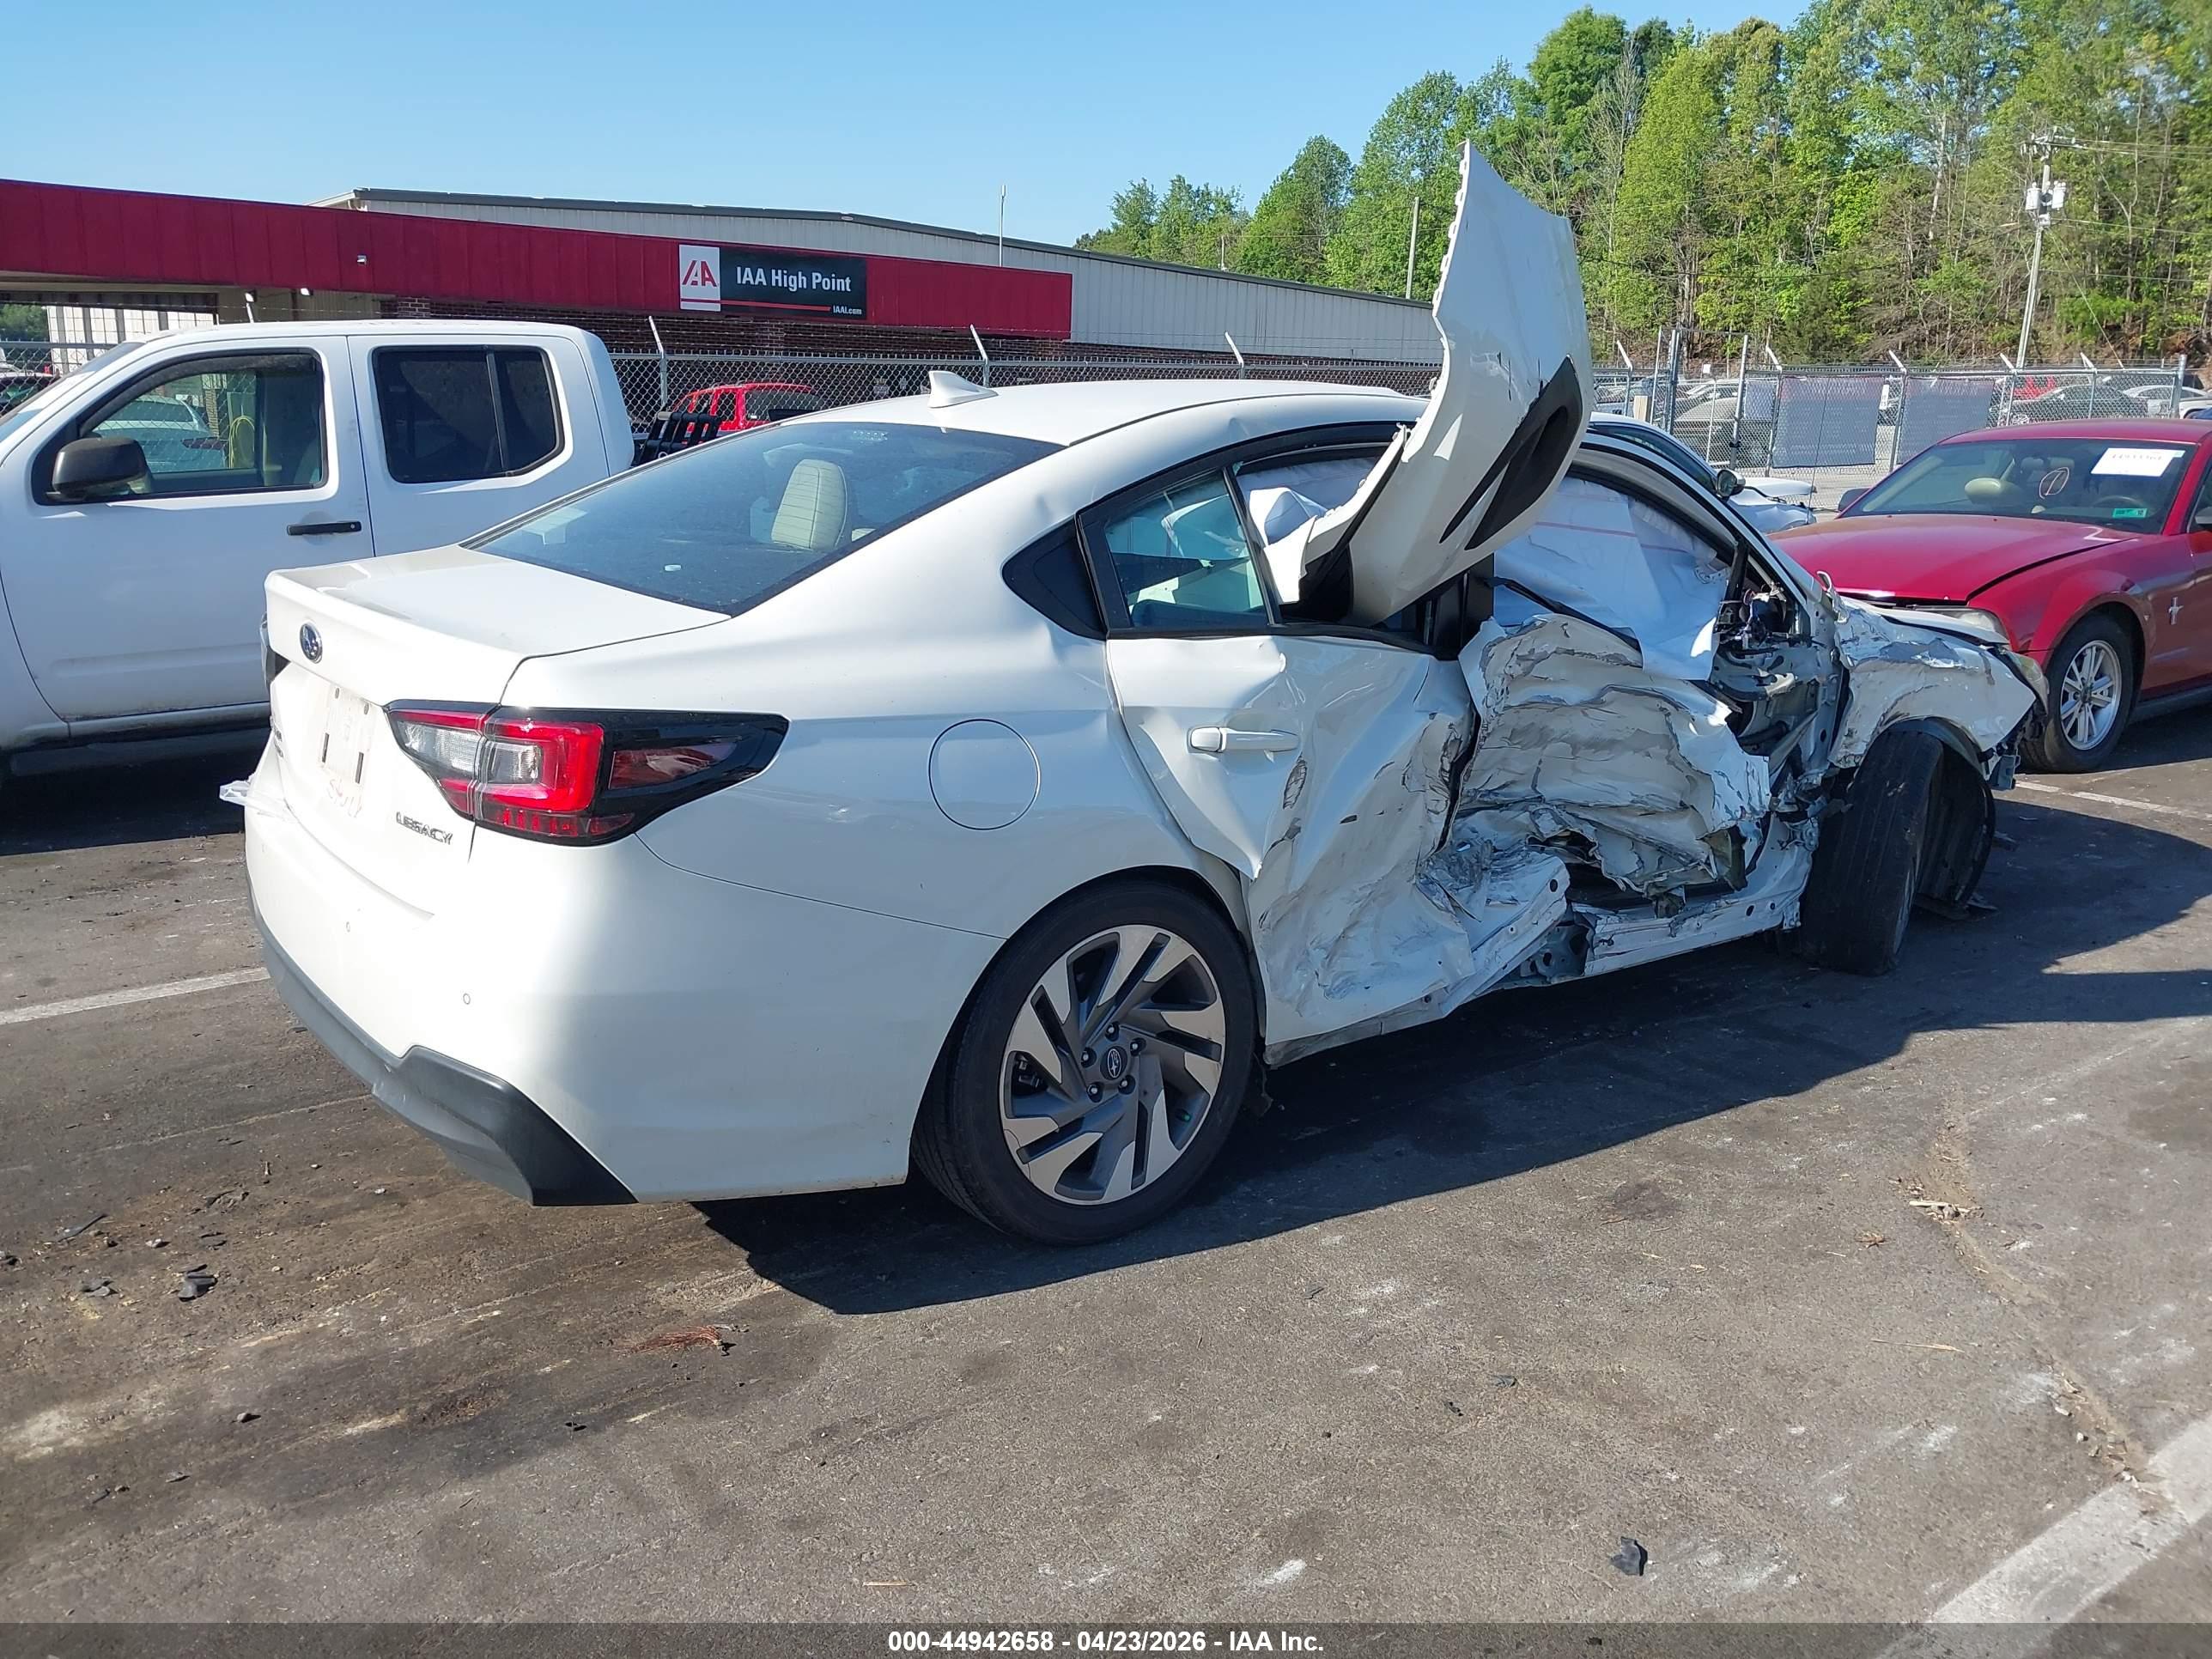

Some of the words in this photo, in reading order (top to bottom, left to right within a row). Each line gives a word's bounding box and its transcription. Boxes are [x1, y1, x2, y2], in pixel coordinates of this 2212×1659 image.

[736, 266, 767, 286] IAA
[771, 269, 807, 292] High
[811, 271, 852, 292] Point
[396, 811, 453, 845] LEGACY
